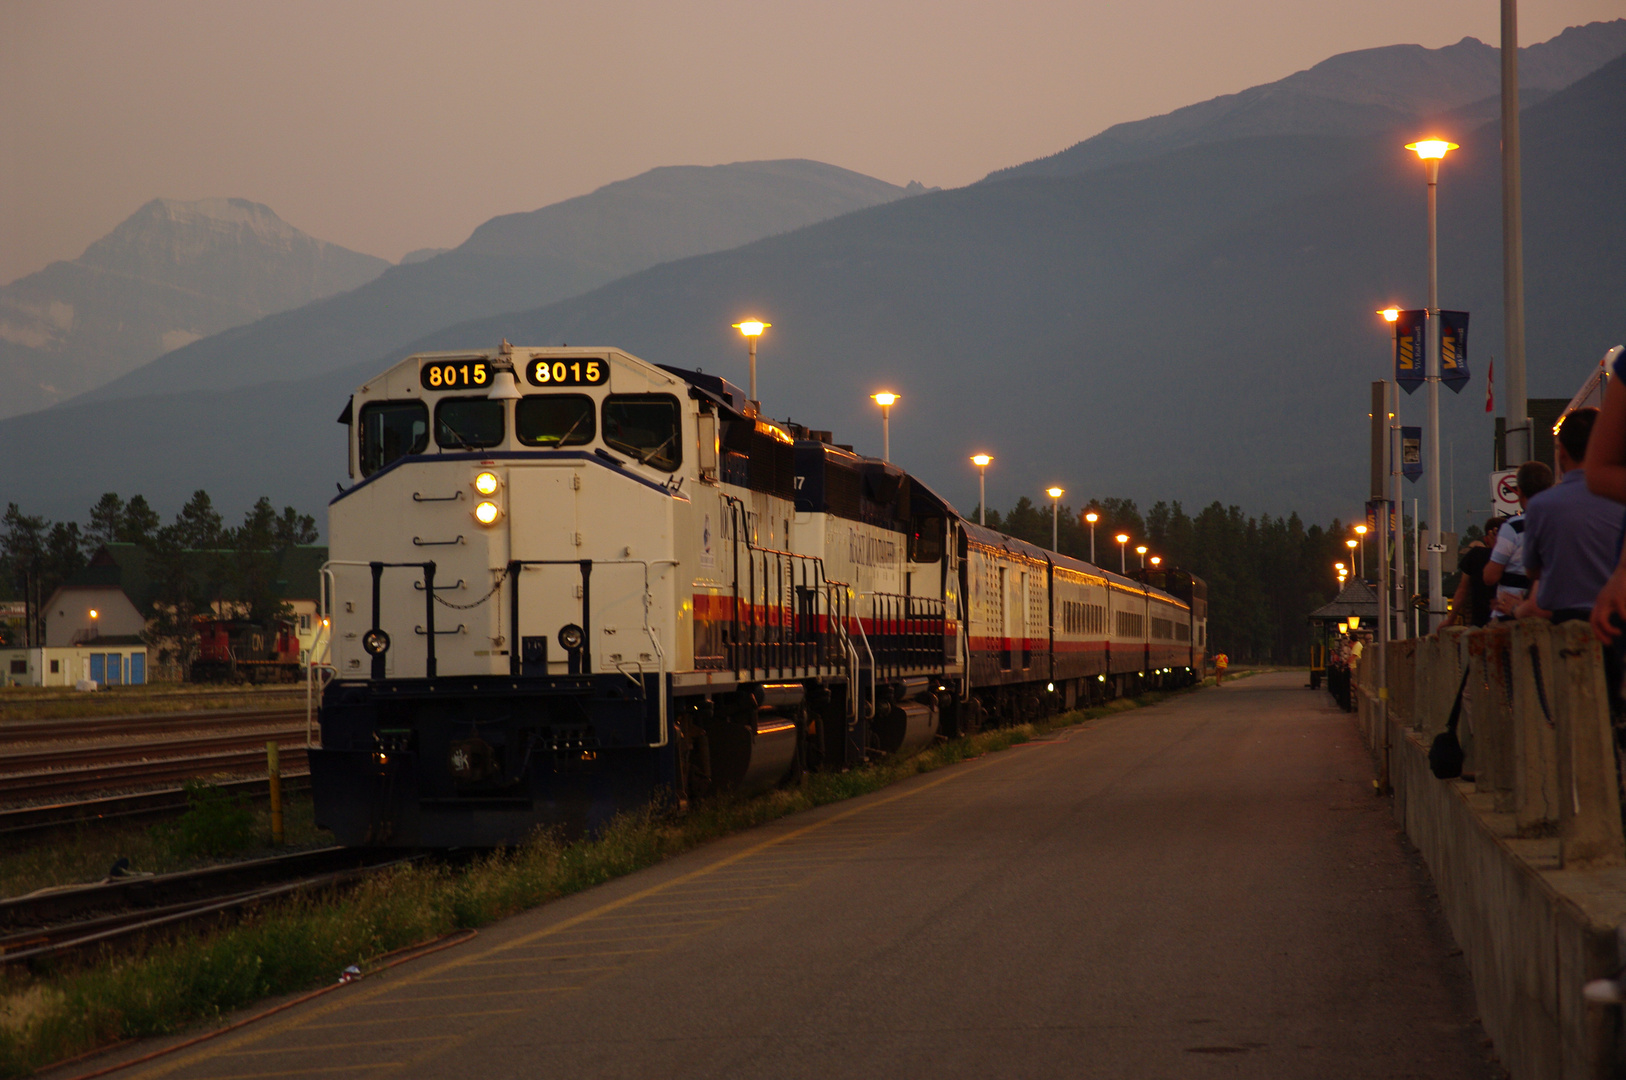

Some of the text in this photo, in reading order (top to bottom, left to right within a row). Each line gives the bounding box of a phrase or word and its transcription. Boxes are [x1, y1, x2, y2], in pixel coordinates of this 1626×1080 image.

[1400, 336, 1413, 369] VIA
[1442, 336, 1457, 369] VIA
[429, 363, 487, 387] 8015
[535, 361, 601, 383] 8015
